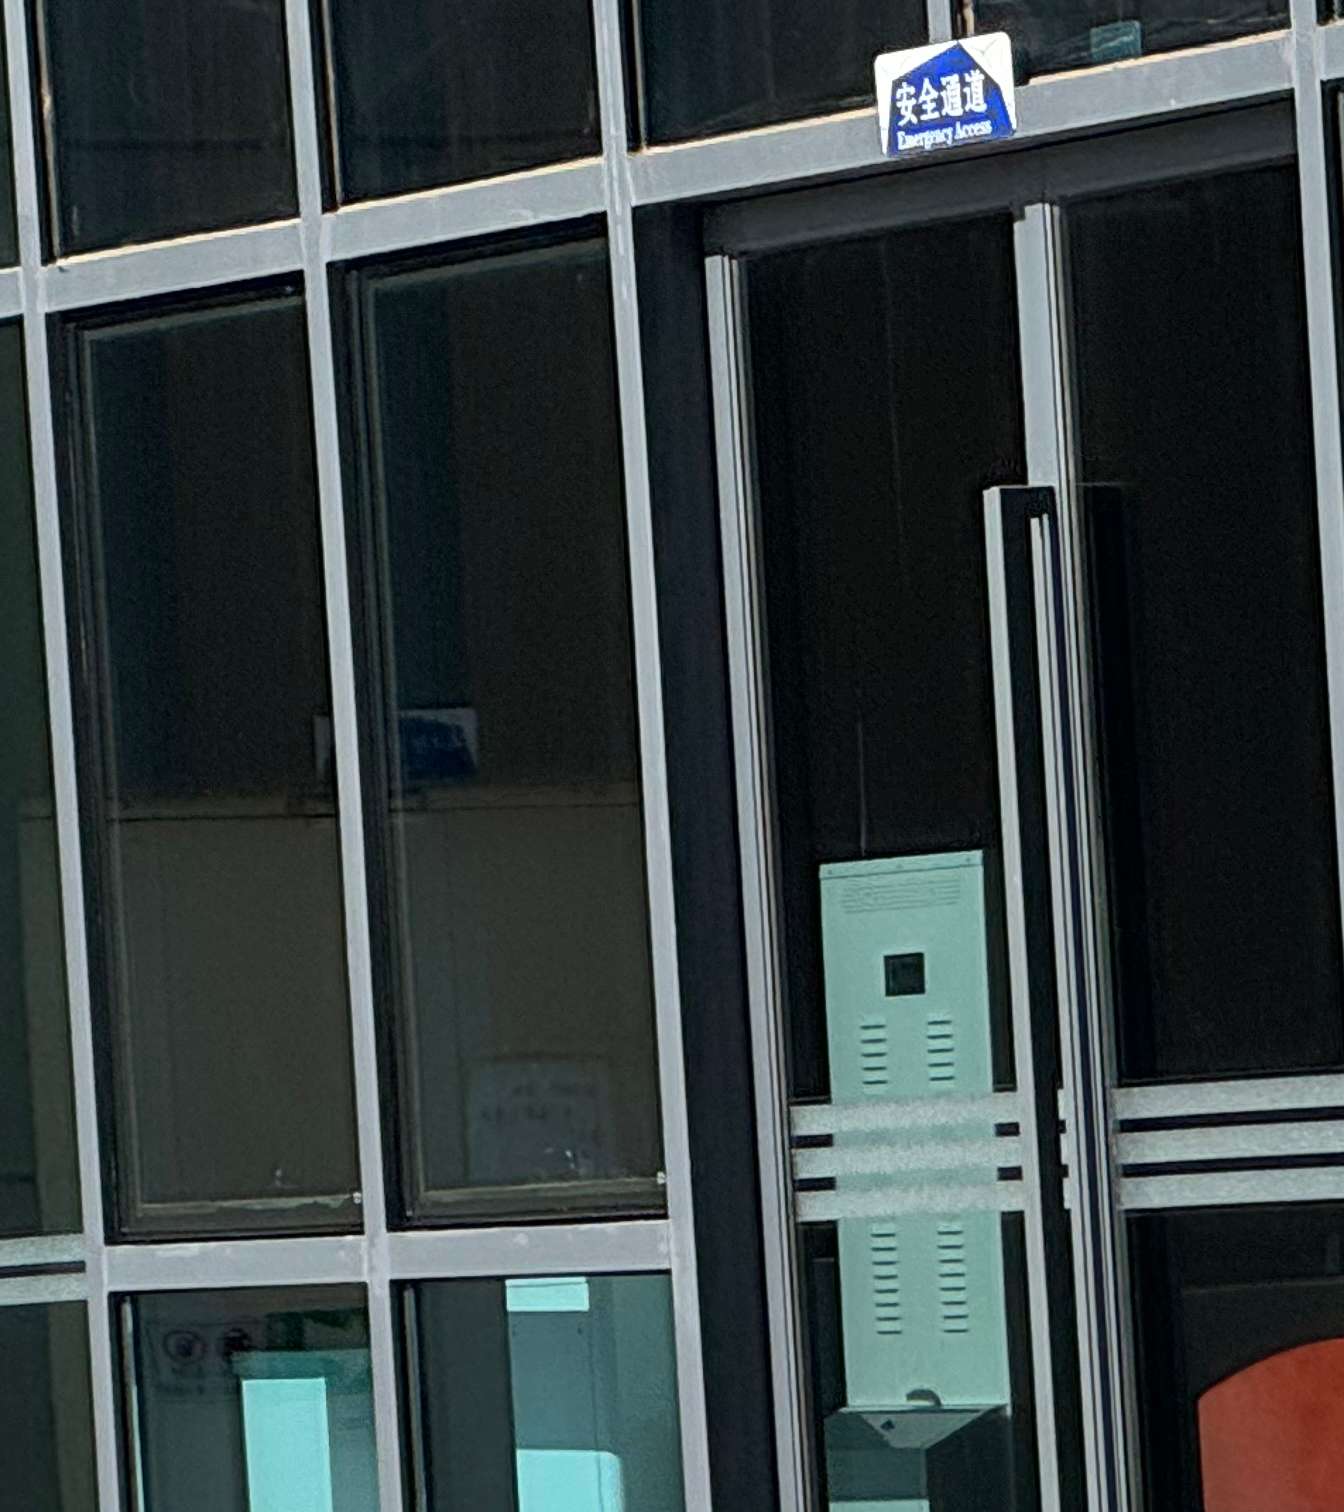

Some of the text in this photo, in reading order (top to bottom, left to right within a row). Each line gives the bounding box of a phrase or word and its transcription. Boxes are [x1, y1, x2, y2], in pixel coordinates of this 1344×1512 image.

[896, 69, 988, 127] 安全通道
[897, 120, 993, 150] Emergency Access
